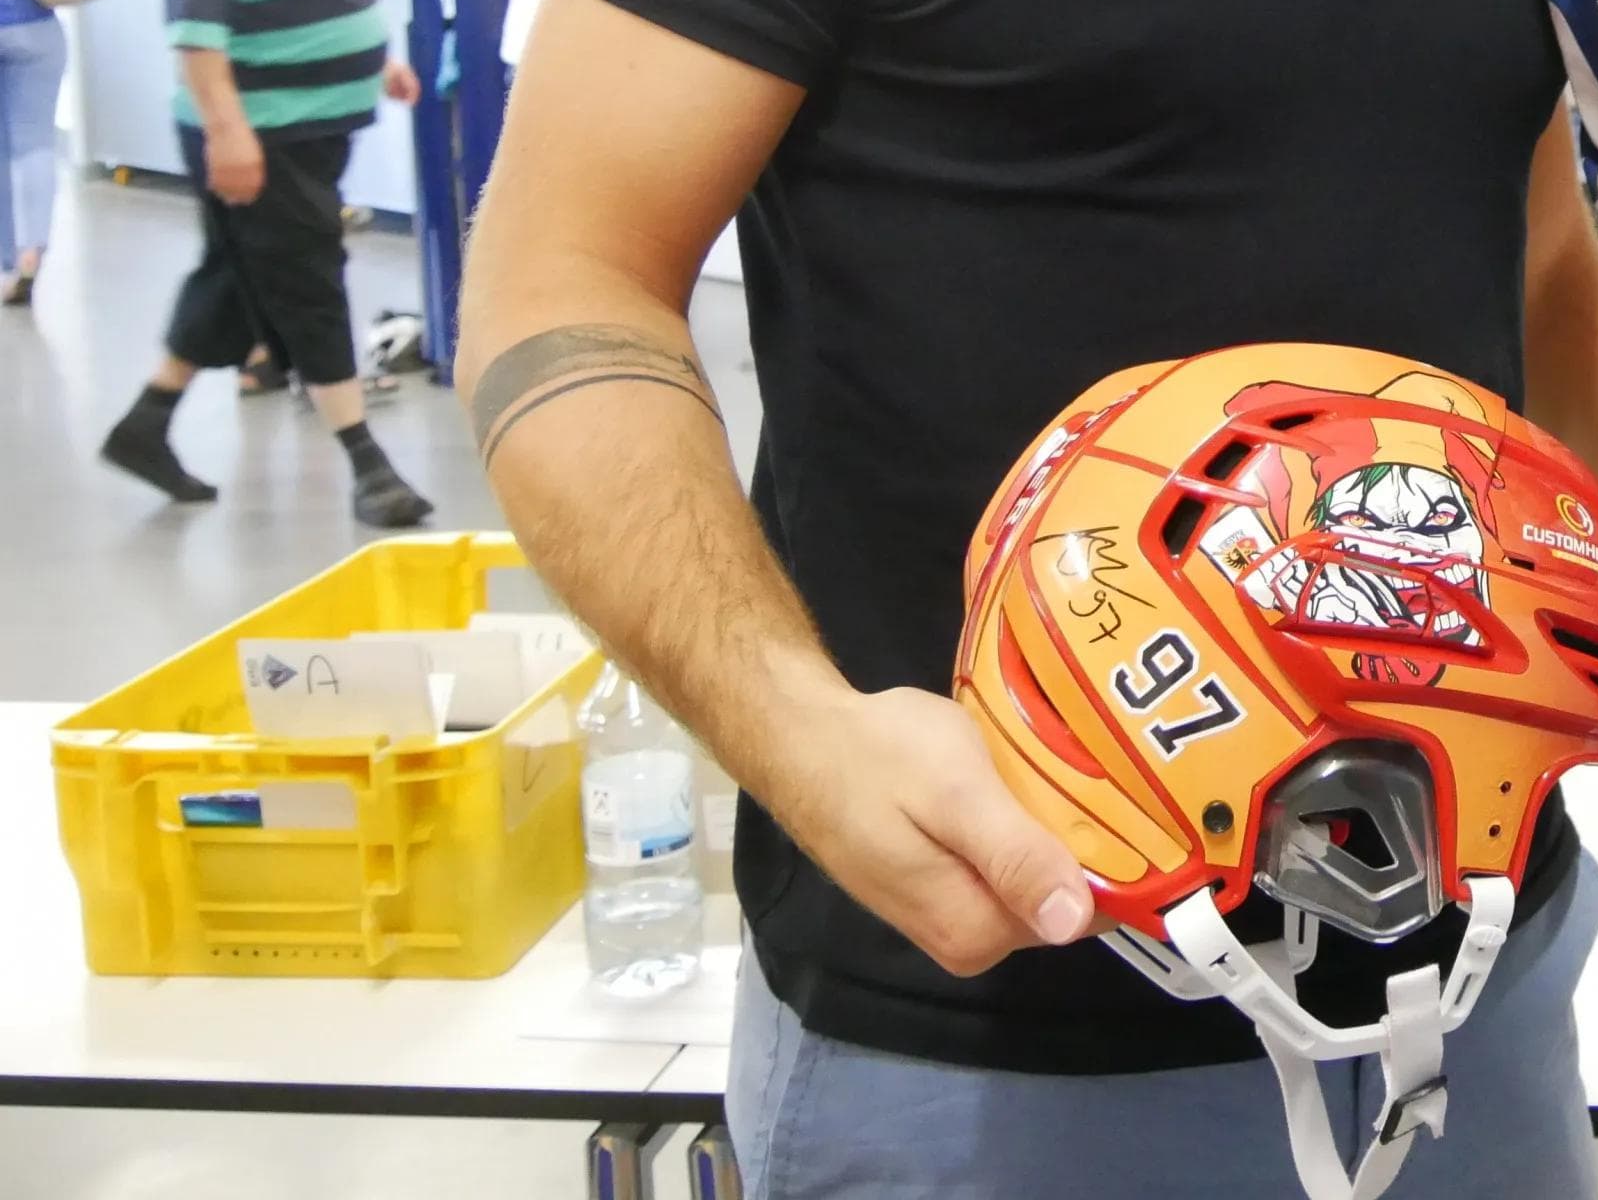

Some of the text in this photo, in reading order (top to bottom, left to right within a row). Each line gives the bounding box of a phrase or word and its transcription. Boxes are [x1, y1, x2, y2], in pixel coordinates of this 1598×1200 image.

[1068, 589, 1123, 644] 97
[306, 654, 340, 695] A
[1110, 626, 1248, 762] 97
